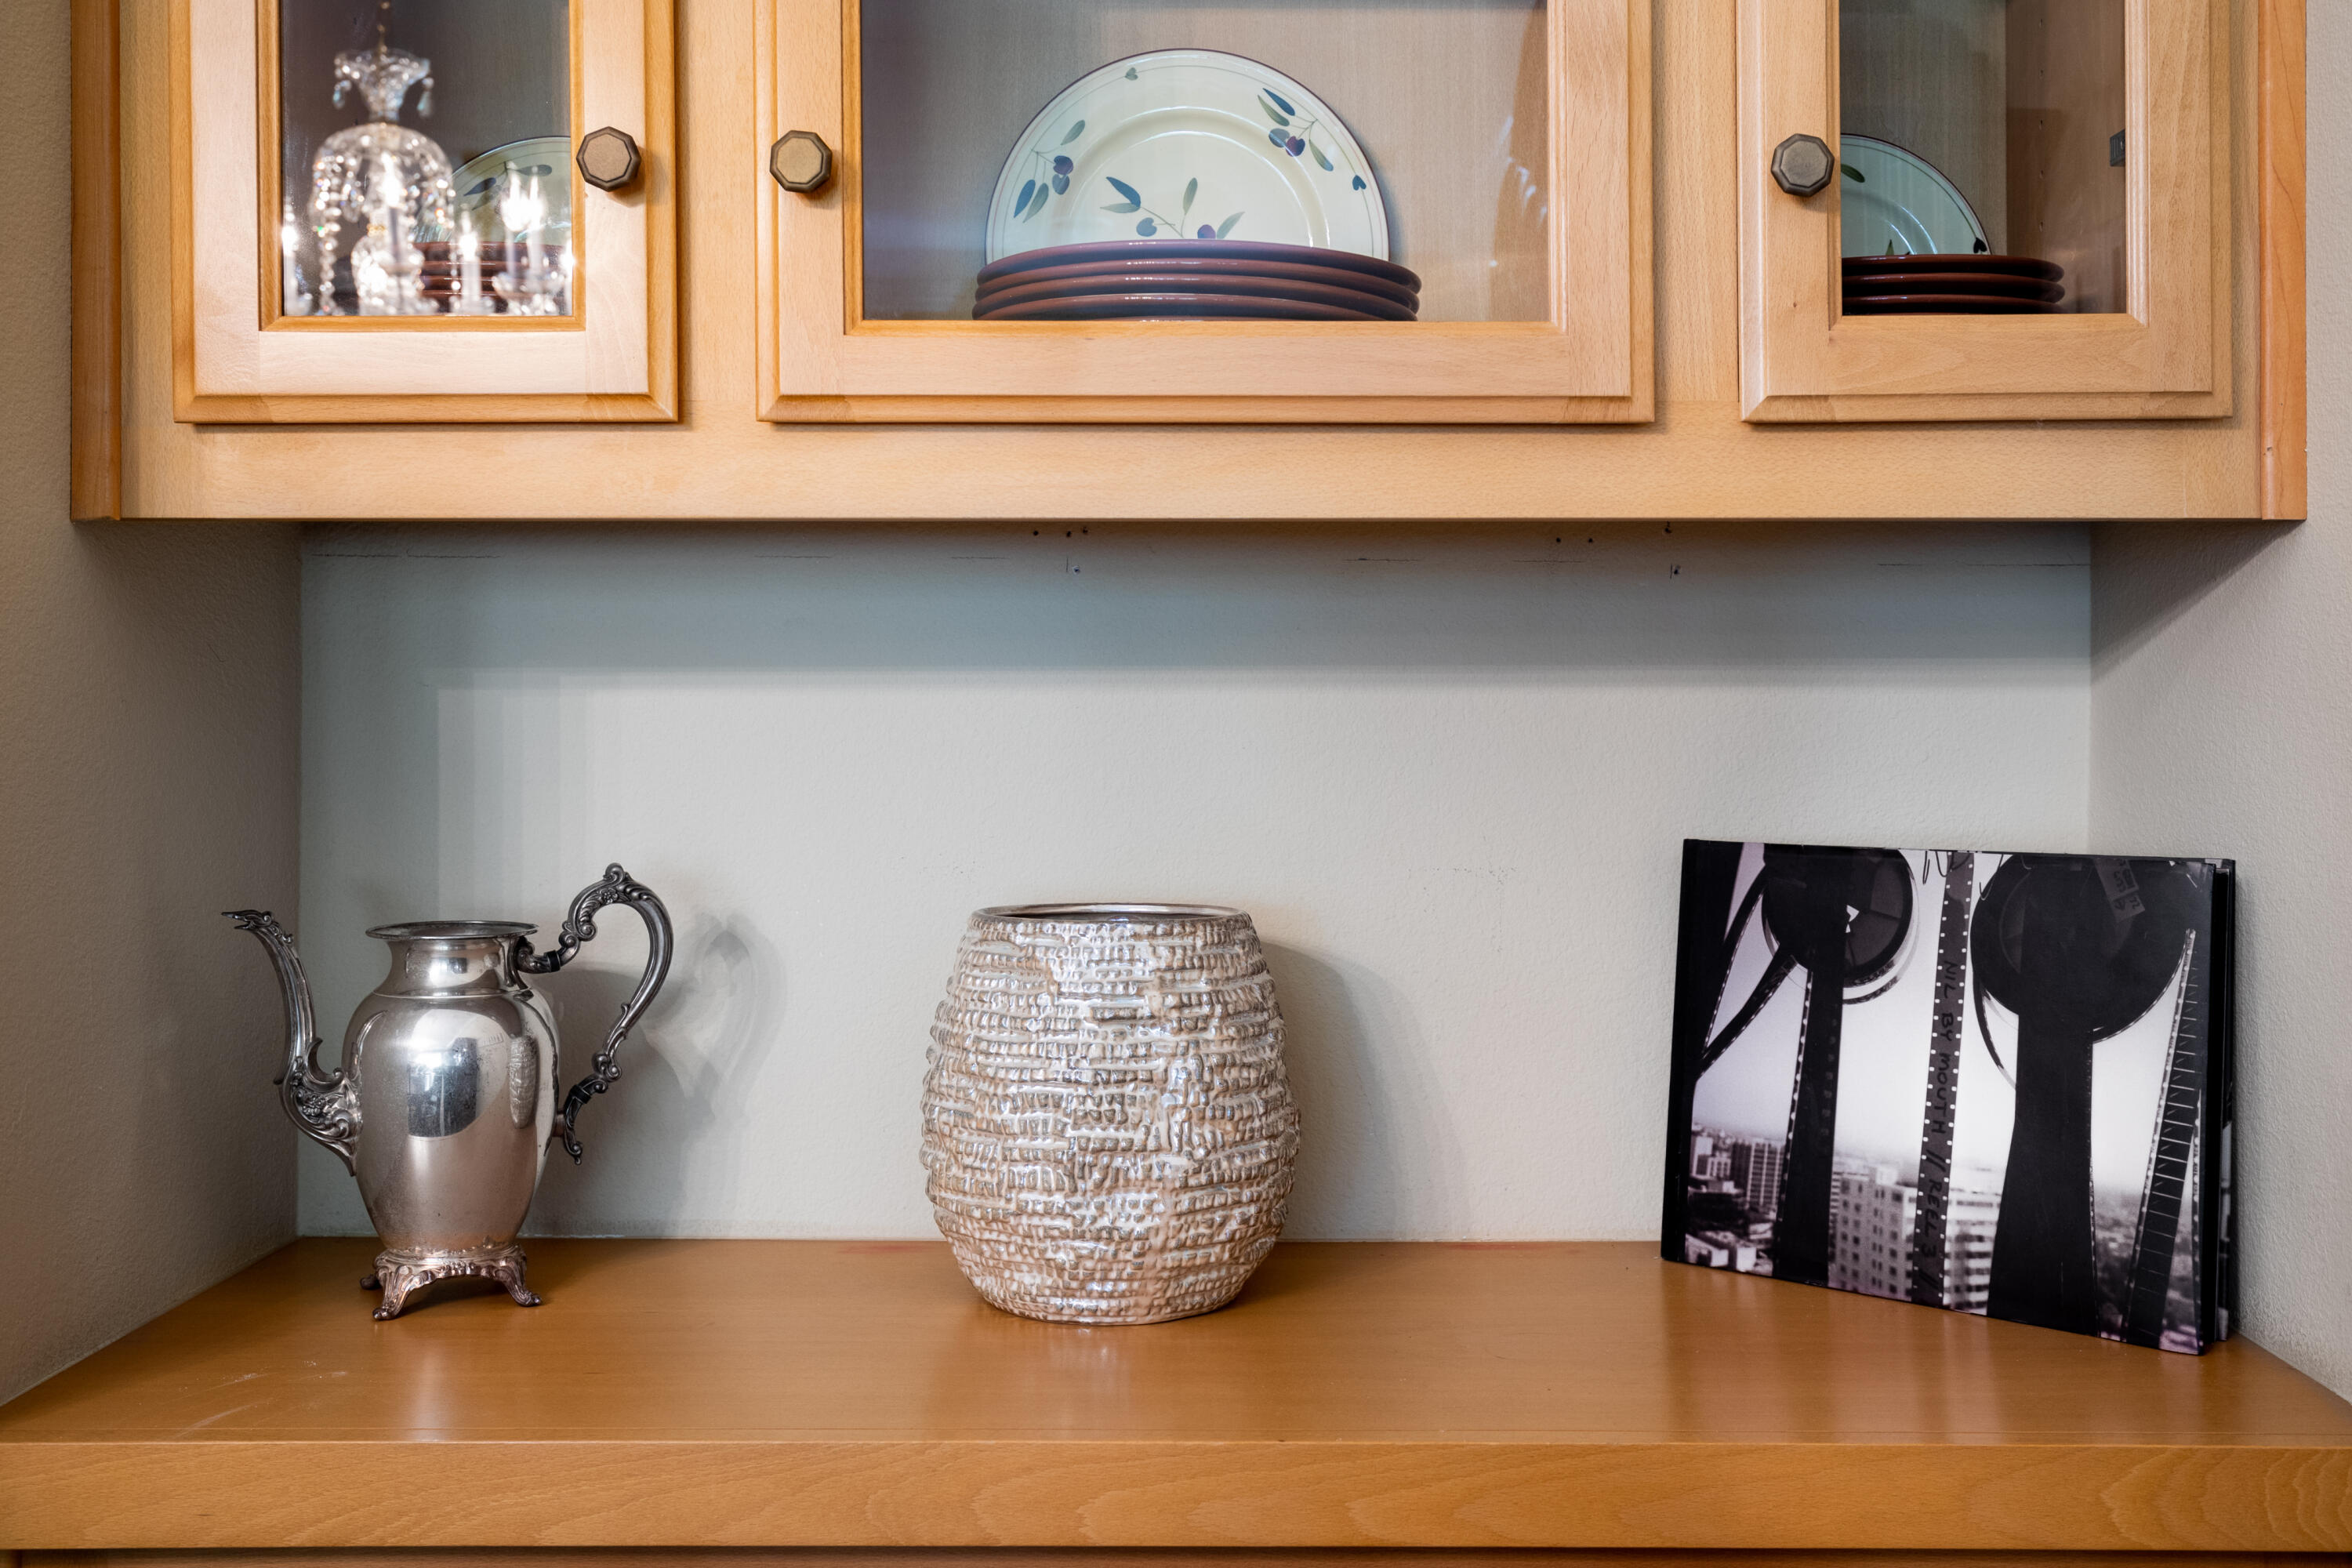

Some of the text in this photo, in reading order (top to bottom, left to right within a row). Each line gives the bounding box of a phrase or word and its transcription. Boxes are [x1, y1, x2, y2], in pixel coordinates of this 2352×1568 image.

[1943, 960, 1958, 999] NIL
[1940, 1011, 1955, 1042] BY
[1931, 1052, 1951, 1134] MOUTH
[1925, 1178, 1943, 1237] REEL
[1922, 1243, 1936, 1258] 3
